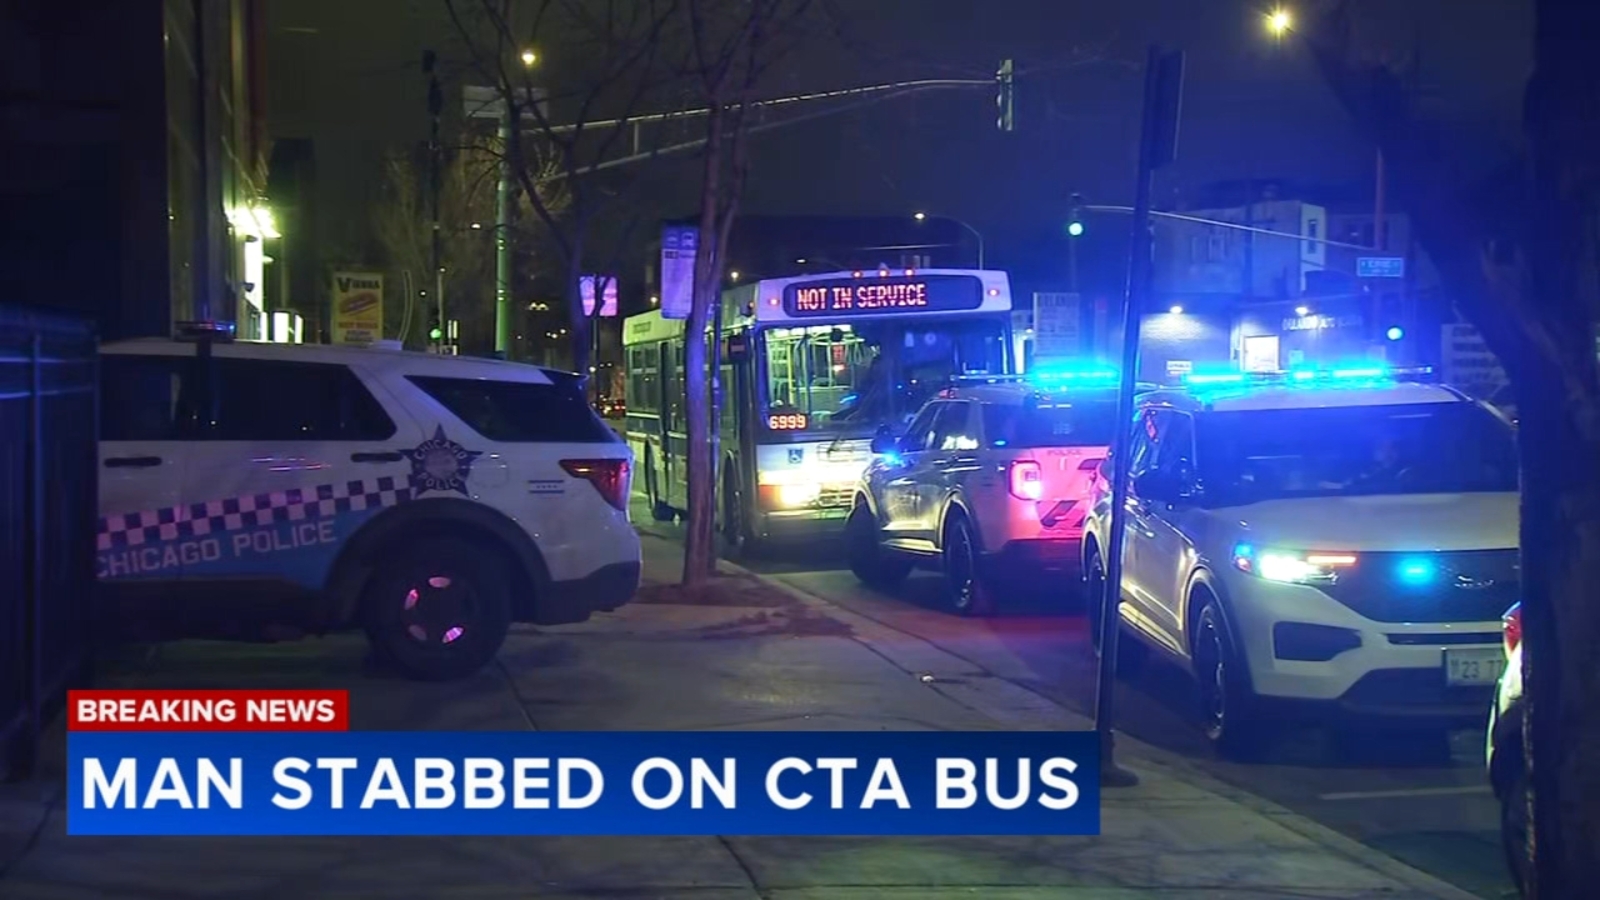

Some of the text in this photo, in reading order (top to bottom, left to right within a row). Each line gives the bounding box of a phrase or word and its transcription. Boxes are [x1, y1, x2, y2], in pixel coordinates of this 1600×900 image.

[797, 283, 926, 310] NOT IN SERVICE
[769, 414, 806, 430] 6999
[413, 439, 467, 460] CHICAGO
[96, 520, 337, 578] CHICAGO POLICE
[1461, 660, 1481, 679] 23
